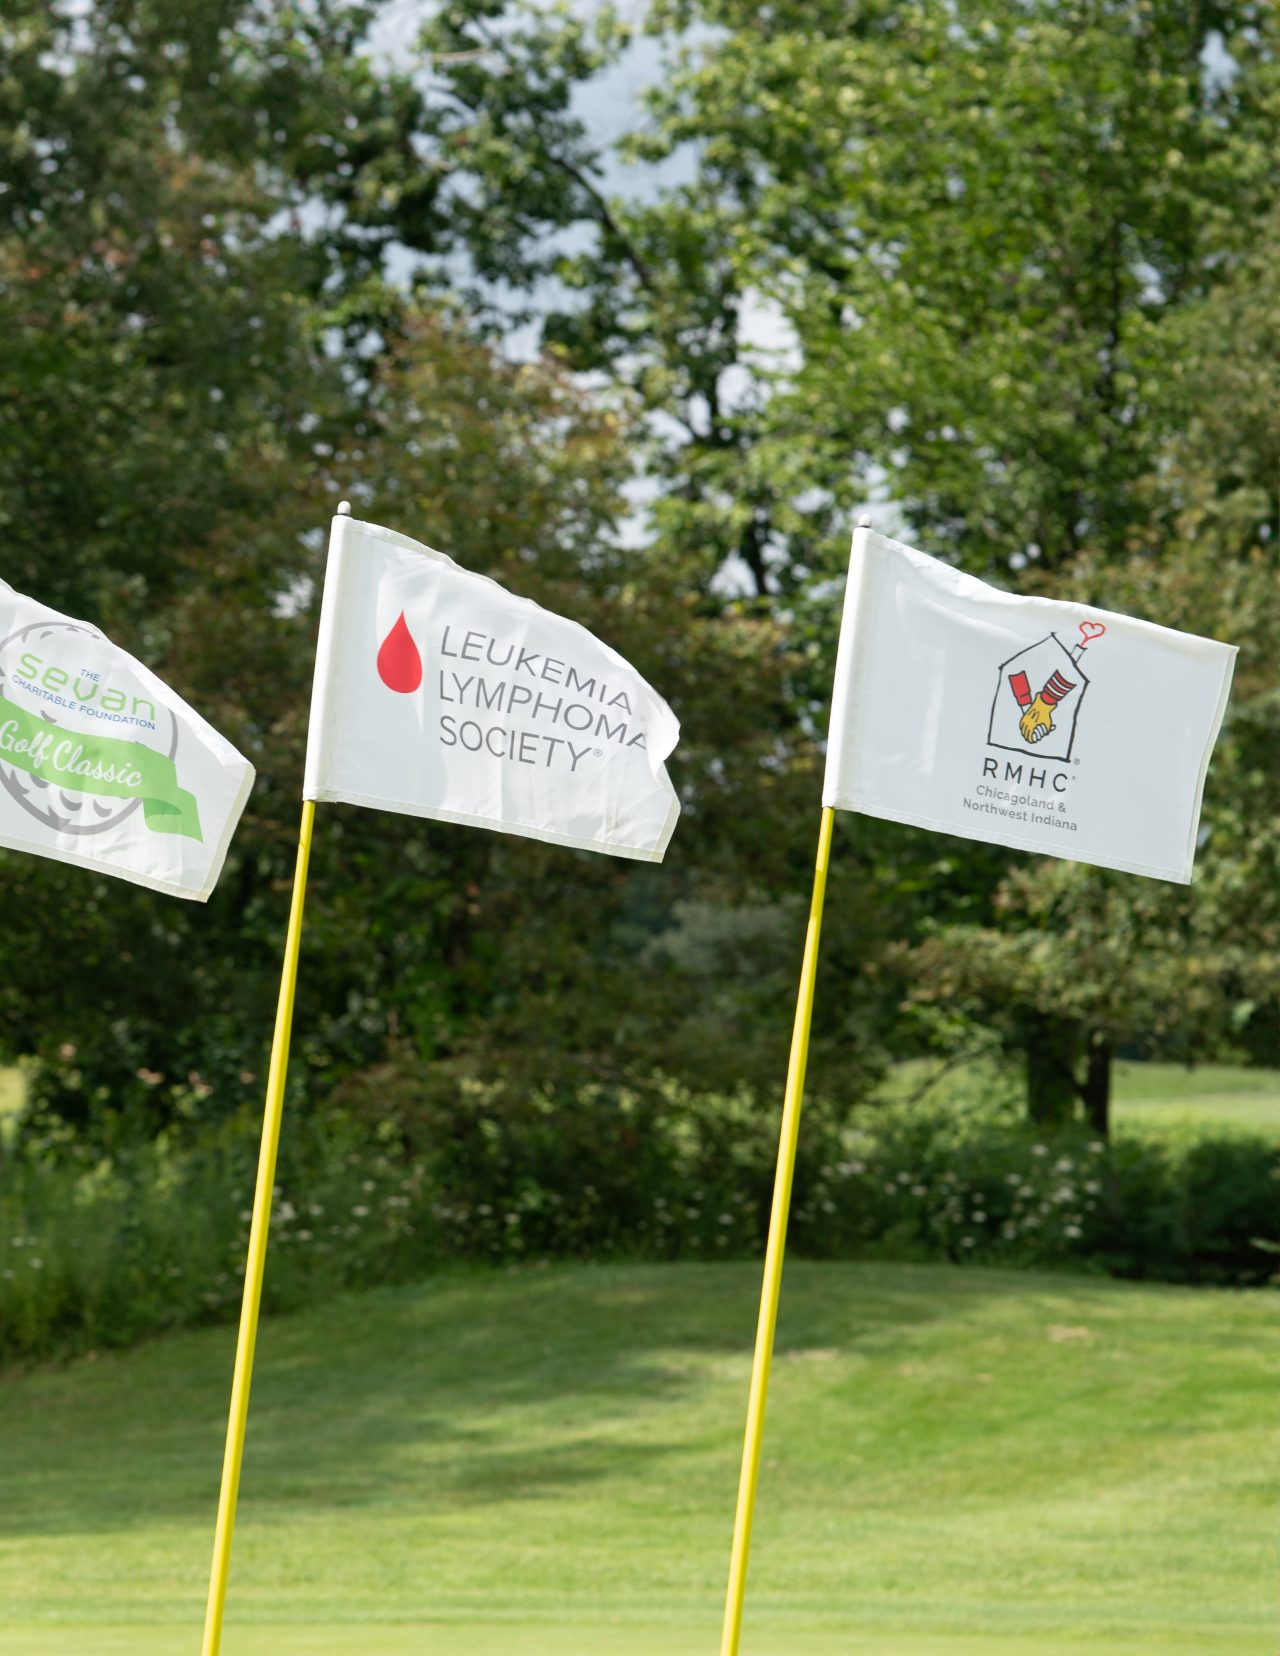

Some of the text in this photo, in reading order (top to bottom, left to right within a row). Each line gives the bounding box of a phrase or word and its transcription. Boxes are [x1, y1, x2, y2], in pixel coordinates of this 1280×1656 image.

[16, 653, 155, 721] sevan
[80, 668, 101, 682] THE
[440, 625, 632, 715] LEUKEMIA
[12, 674, 156, 730] CHARITABLE FOUNDATION
[440, 670, 647, 750] LYMPHOMA
[52, 740, 143, 787] Classic
[439, 715, 593, 772] SOCIETY
[976, 785, 1066, 813] Chicagoland &
[983, 757, 1068, 792] RMHC
[963, 797, 1078, 831] Northwest Indiana
